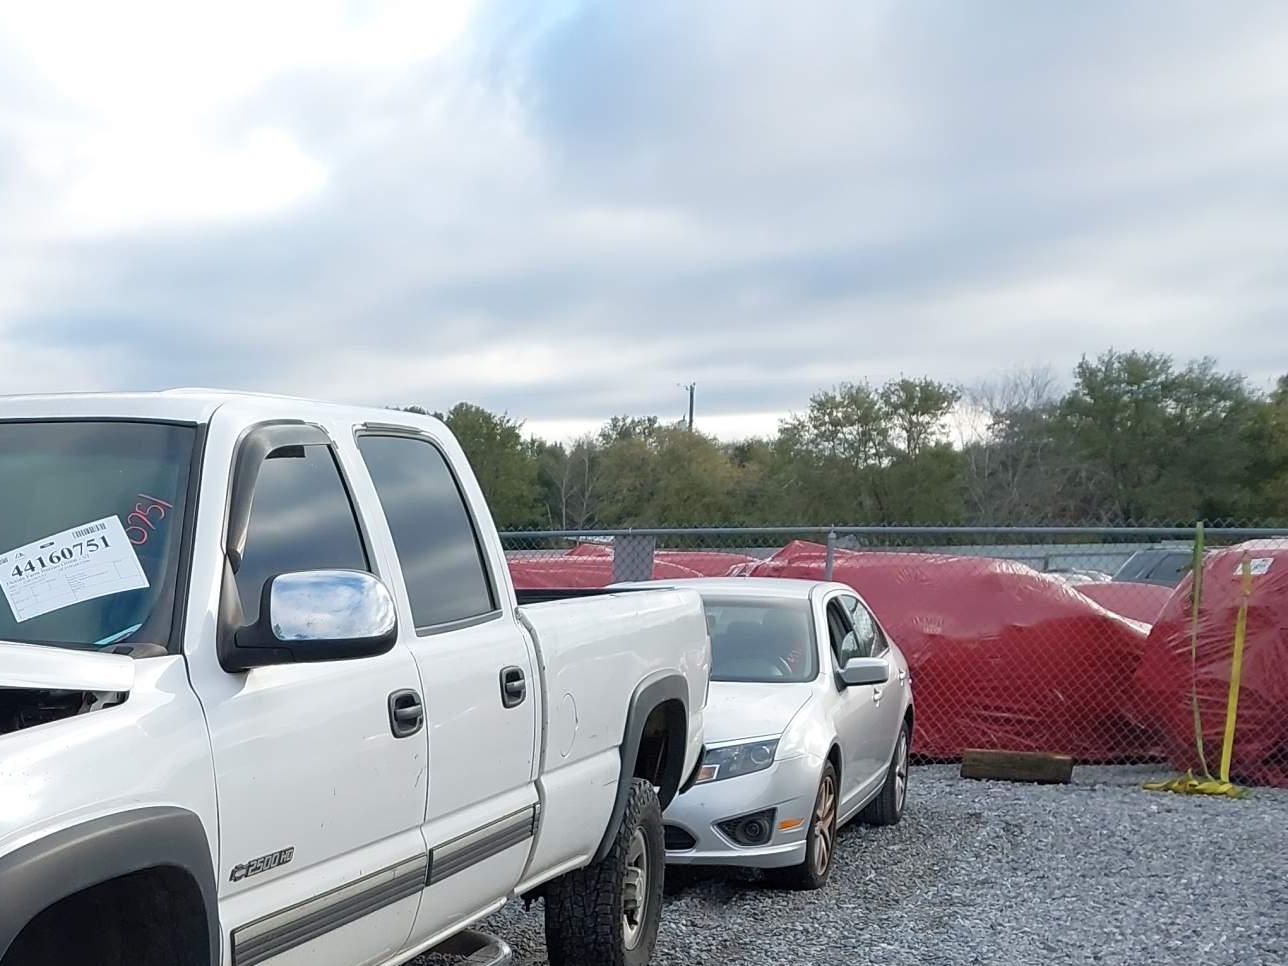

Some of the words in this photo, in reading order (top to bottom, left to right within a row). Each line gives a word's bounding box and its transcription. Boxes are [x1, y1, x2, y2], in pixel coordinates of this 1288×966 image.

[11, 535, 111, 577] 44160751
[248, 853, 280, 876] 2500
[280, 849, 294, 863] HD
